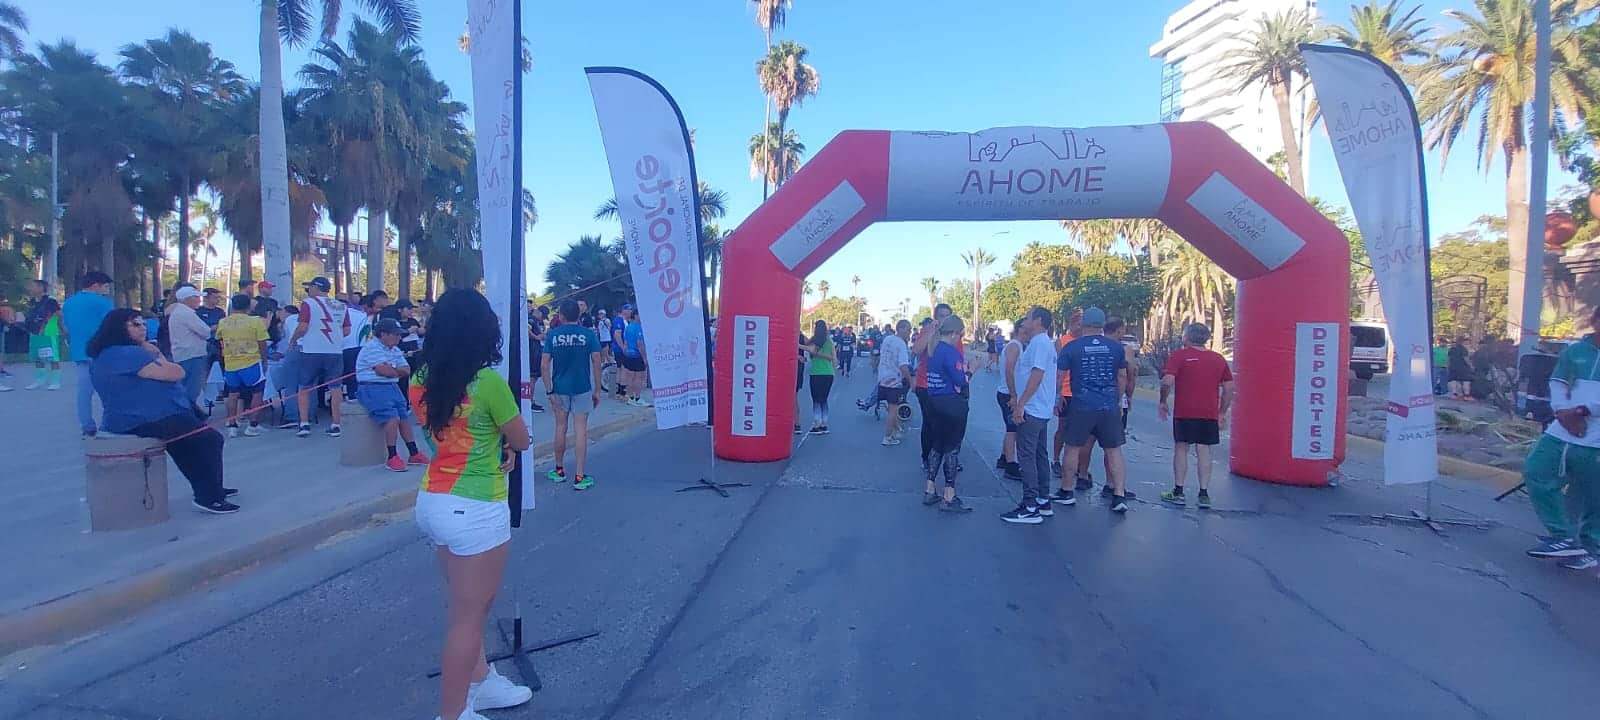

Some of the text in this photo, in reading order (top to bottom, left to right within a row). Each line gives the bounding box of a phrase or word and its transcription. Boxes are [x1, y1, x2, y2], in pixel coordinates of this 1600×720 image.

[960, 165, 1107, 195] AHOME
[552, 334, 586, 347] ASICS
[743, 320, 757, 431] DEPORTES
[1309, 327, 1328, 454] DEPORTES
